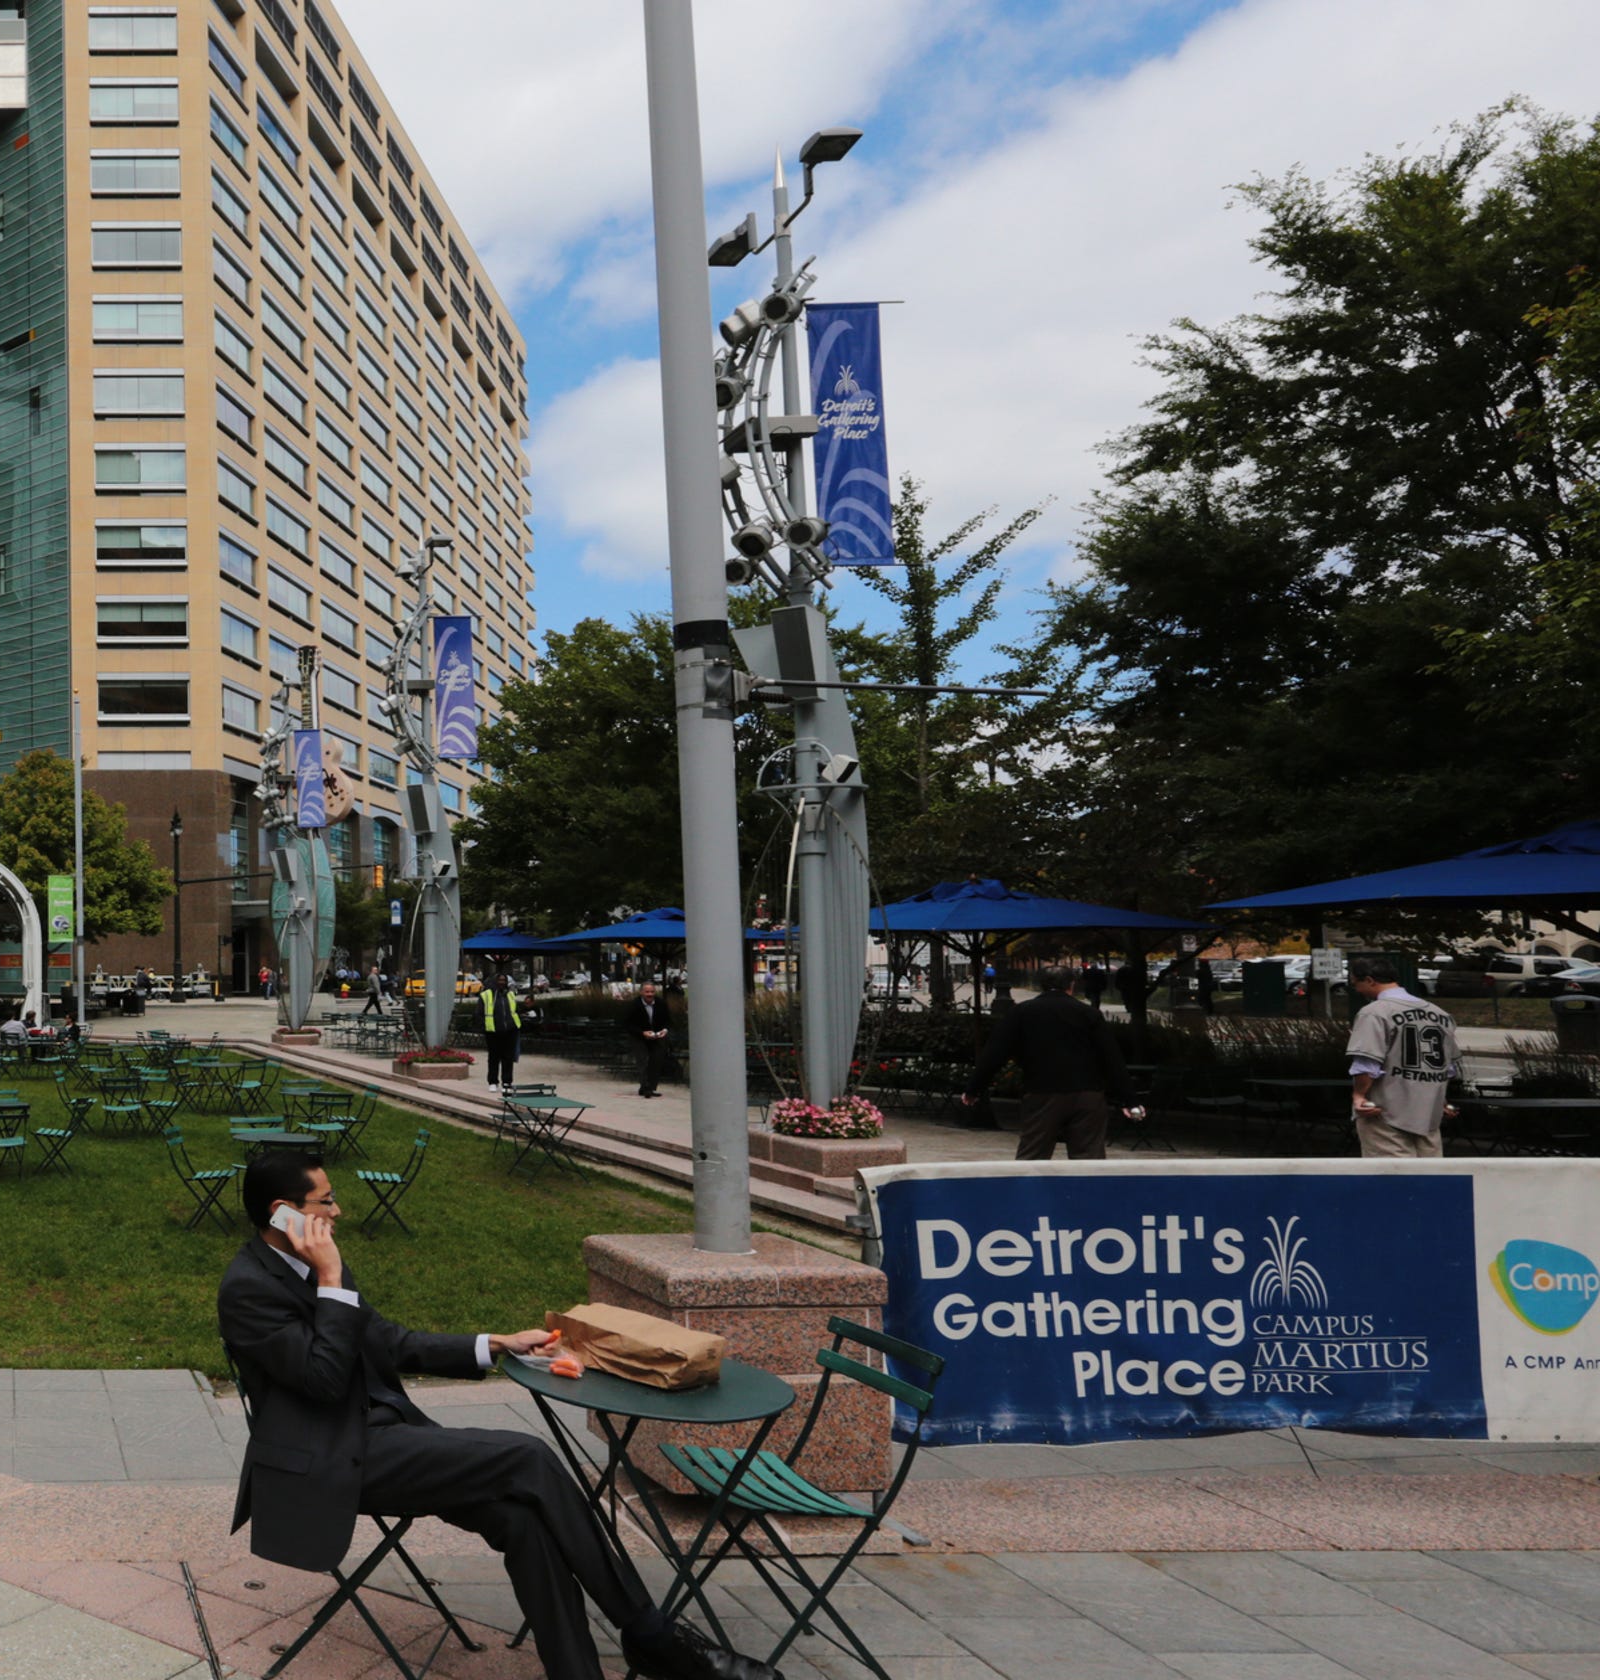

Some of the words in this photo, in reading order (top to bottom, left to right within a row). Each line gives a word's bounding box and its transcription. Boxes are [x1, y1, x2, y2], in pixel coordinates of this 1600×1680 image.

[821, 398, 876, 412] Detroit's
[817, 412, 880, 432] Gathering
[833, 426, 869, 439] Place
[1401, 1024, 1446, 1070] 13
[916, 1215, 1246, 1280] Detroit's
[933, 1289, 1246, 1347] Gathering
[1253, 1314, 1375, 1336] CAMPUS
[1253, 1340, 1429, 1369] MARTIUS
[1505, 1355, 1518, 1369] A
[1523, 1355, 1566, 1370] CMP
[1072, 1350, 1246, 1397] Place
[1252, 1373, 1334, 1395] PARK
